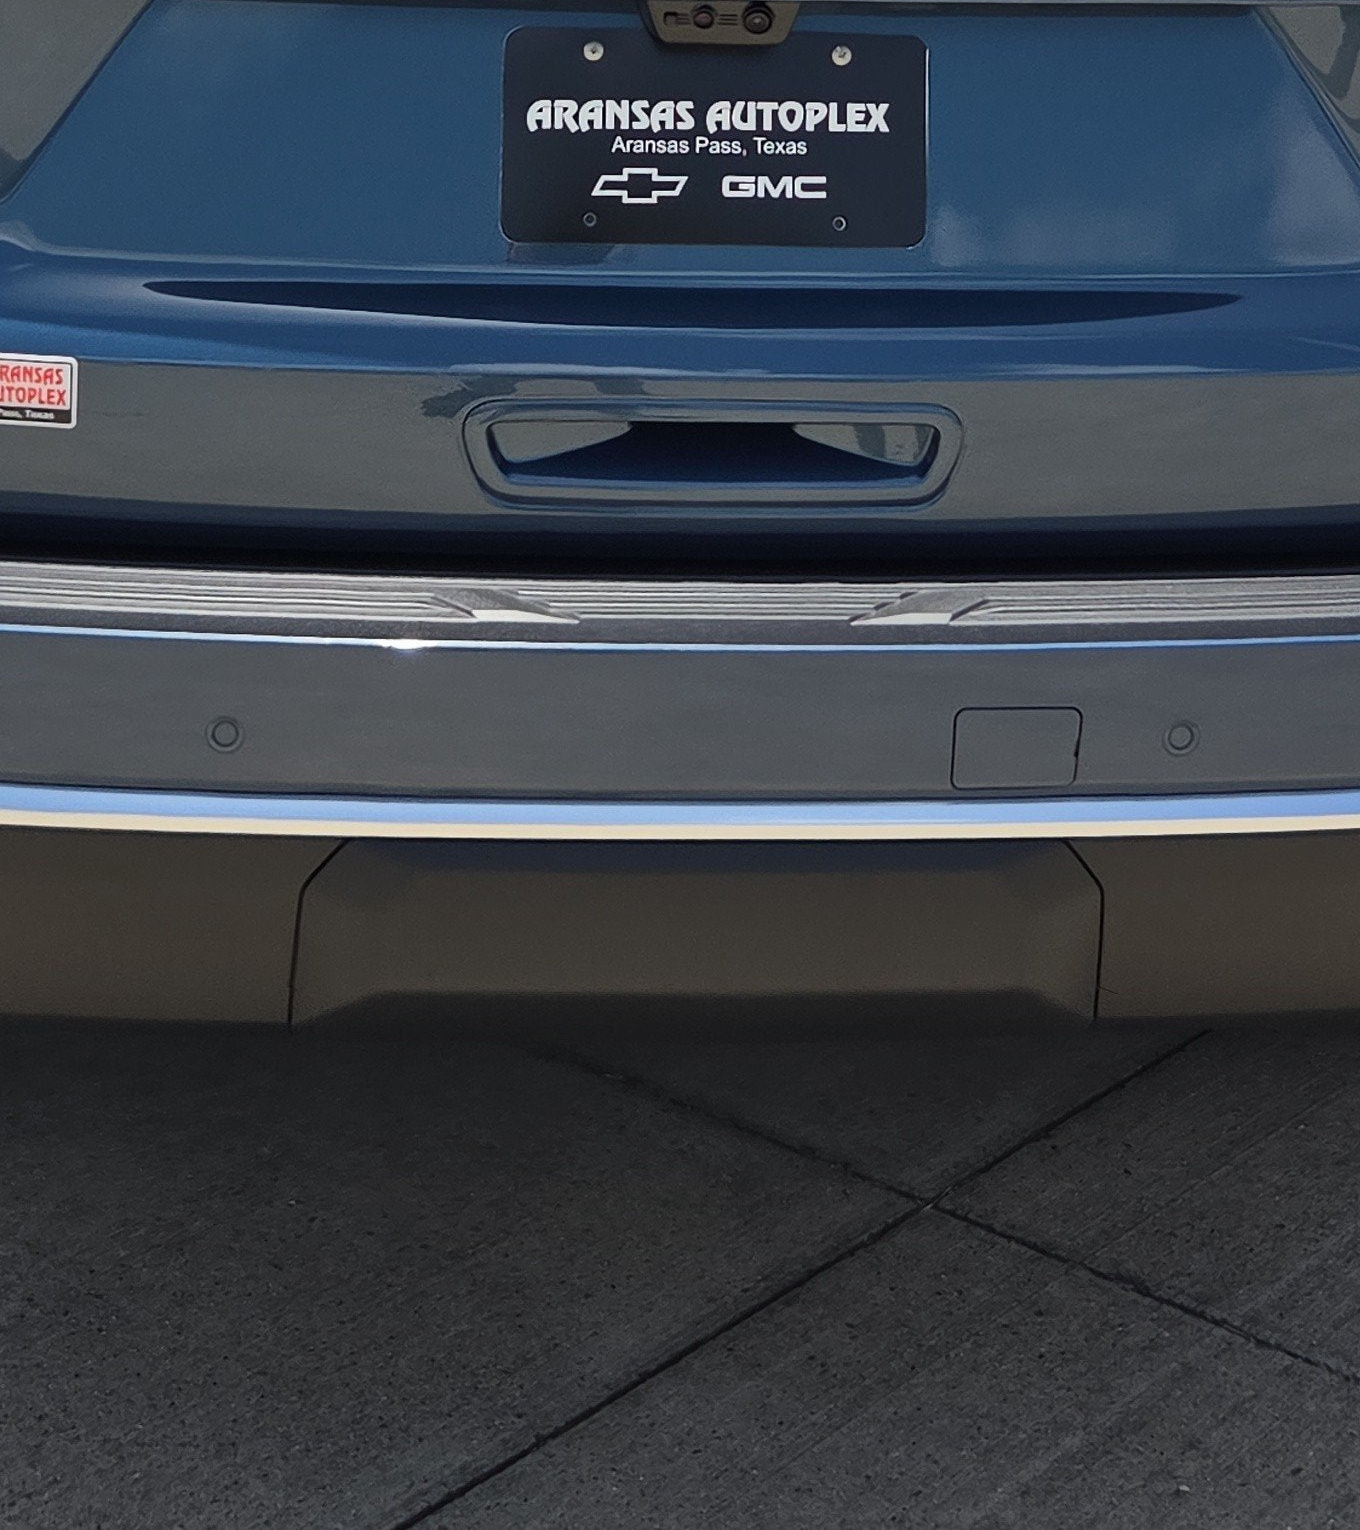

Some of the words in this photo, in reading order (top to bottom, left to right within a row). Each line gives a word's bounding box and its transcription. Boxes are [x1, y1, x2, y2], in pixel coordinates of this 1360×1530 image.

[526, 99, 696, 134] ARANSAS
[705, 100, 890, 134] AUTOPLEX
[611, 135, 690, 154] Aransas
[695, 136, 747, 157] Pass,
[753, 136, 808, 155] Texas
[721, 175, 827, 199] GMC
